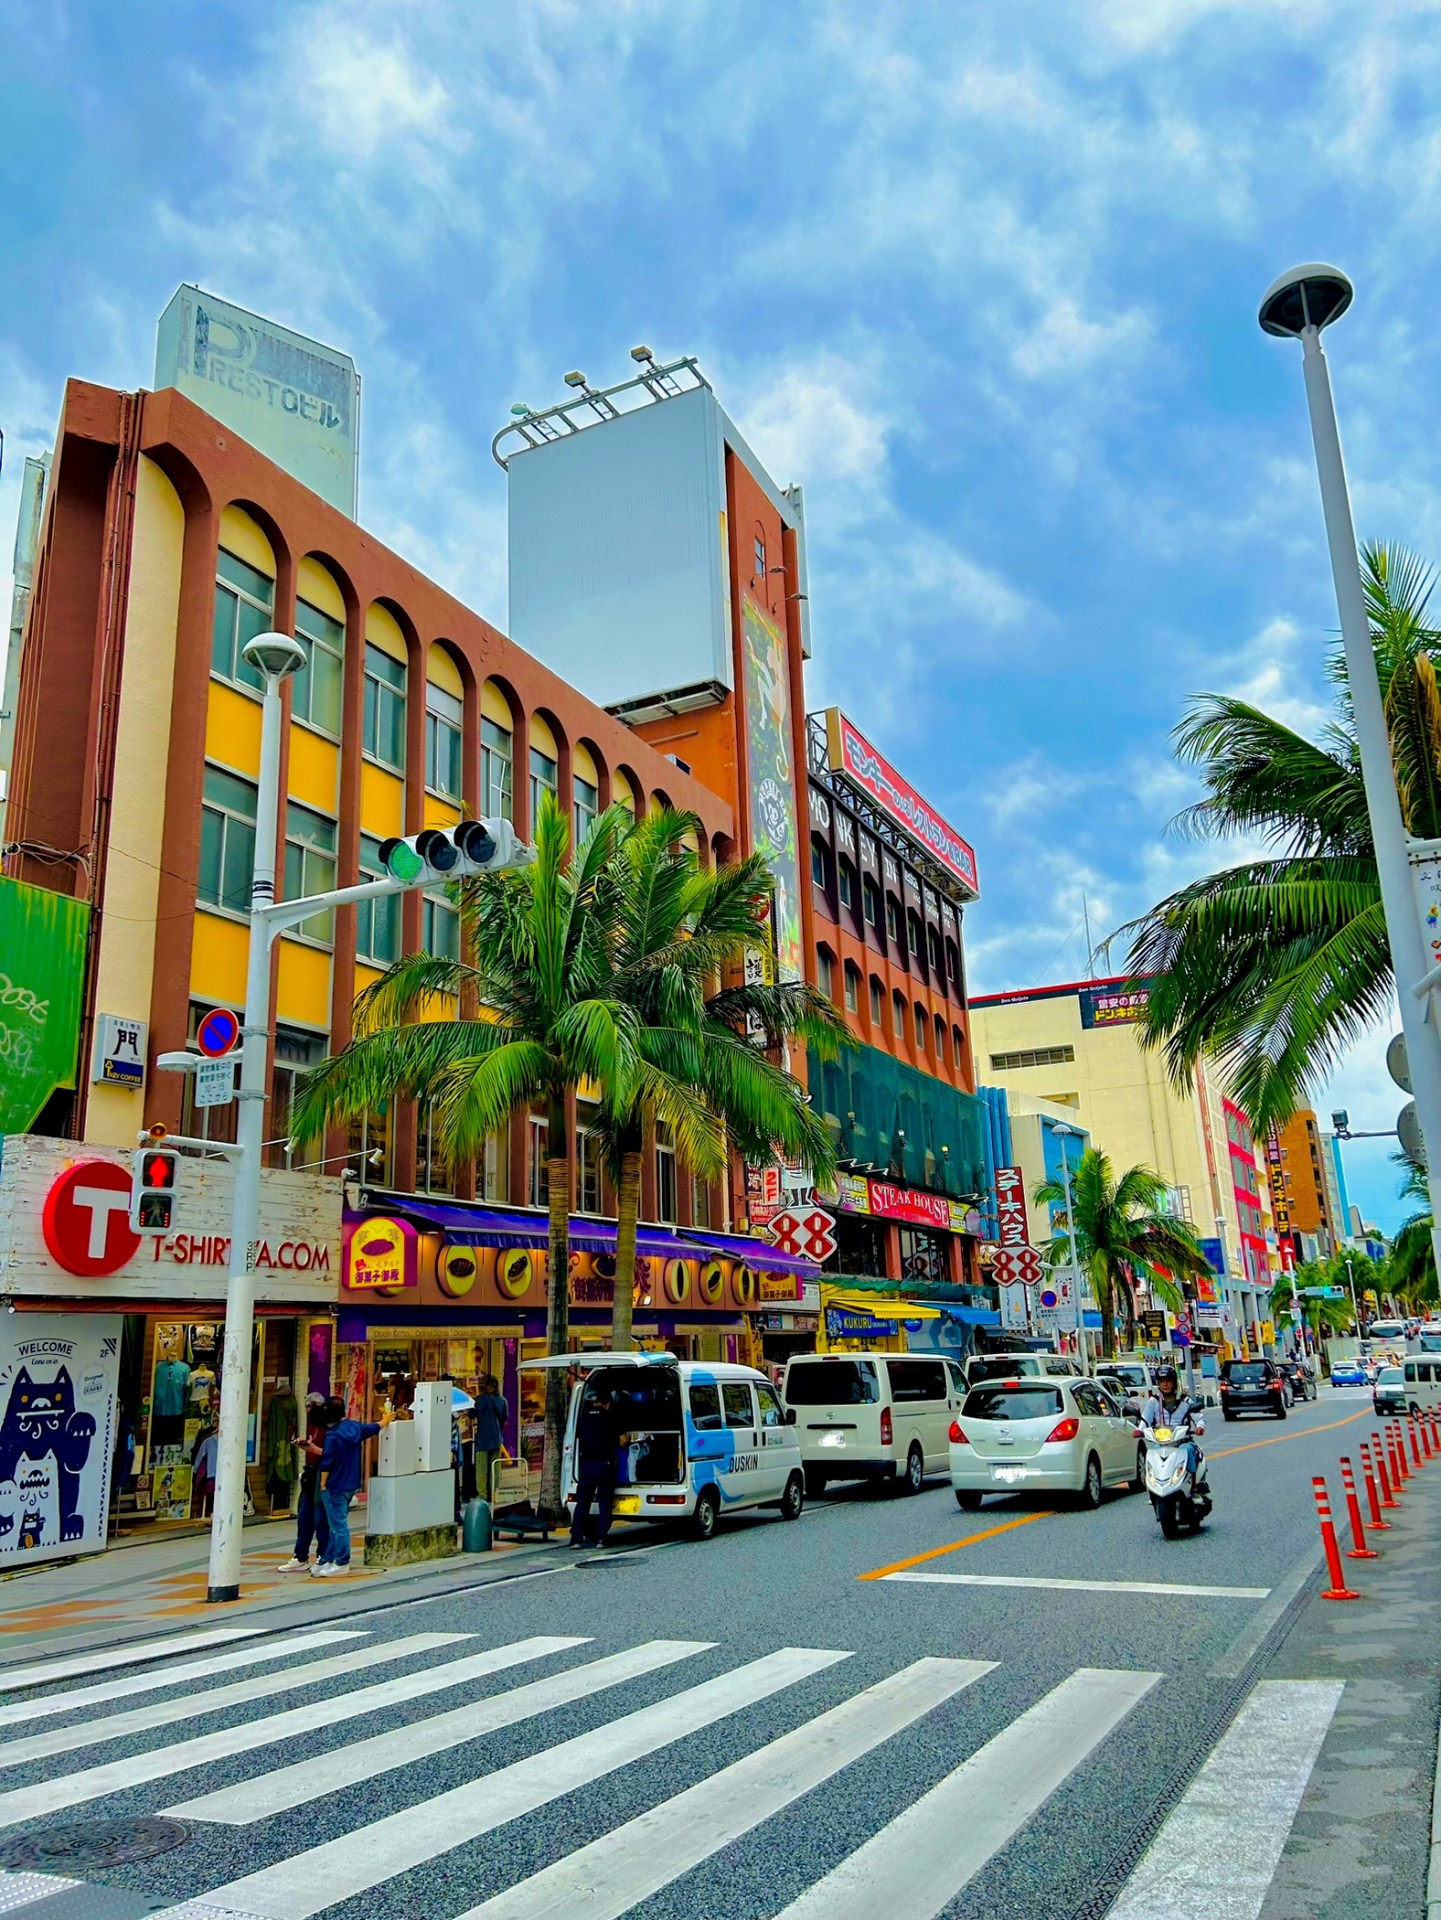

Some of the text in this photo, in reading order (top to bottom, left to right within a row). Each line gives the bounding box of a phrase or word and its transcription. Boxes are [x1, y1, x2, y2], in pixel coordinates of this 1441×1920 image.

[112, 1029, 138, 1056] 門
[872, 1183, 910, 1212] STEAK
[914, 1194, 949, 1226] HOUSE
[997, 1168, 1026, 1246] ステーキハウス
[843, 1317, 872, 1329] KUKURU
[19, 1341, 73, 1356] WELCOME
[100, 1349, 110, 1358] 2F
[729, 1454, 758, 1473] DUSKIN
